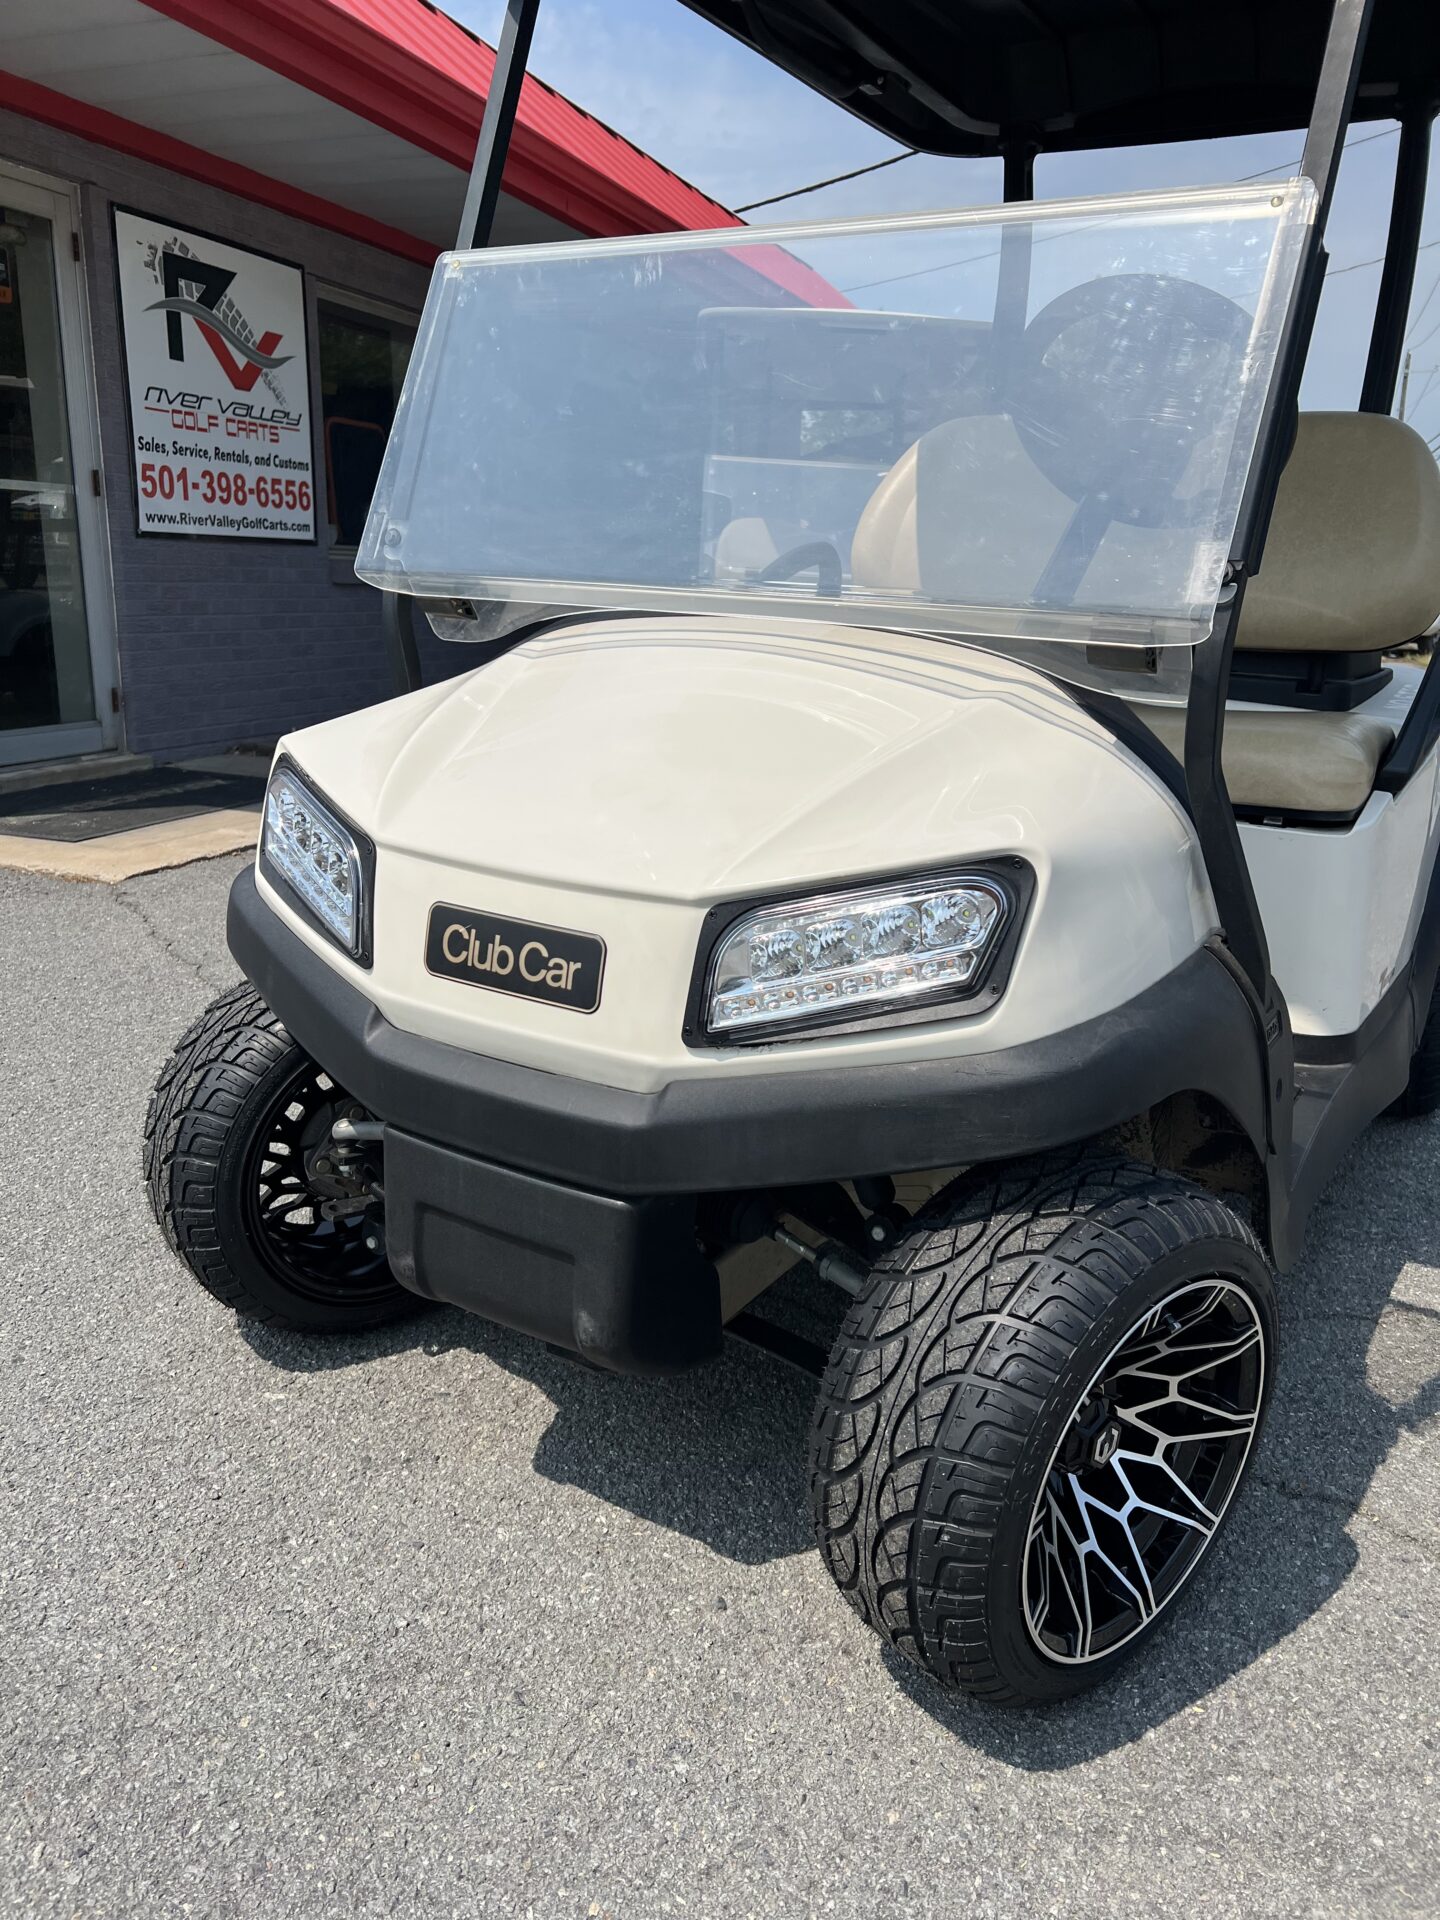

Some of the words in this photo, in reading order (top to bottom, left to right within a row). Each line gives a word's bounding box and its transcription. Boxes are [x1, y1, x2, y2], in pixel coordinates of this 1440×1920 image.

[171, 409, 219, 433] GOLF
[225, 417, 280, 443] CARTS
[137, 436, 169, 456] Sales,
[172, 441, 212, 462] Service,
[214, 447, 252, 467] Rentals,
[254, 453, 271, 467] and
[273, 455, 309, 472] Customs
[141, 463, 311, 512] 501-398-6556
[145, 512, 311, 533] www.RiverValleyGolfCarts.com
[442, 923, 514, 976] Club
[519, 941, 582, 990] Car
